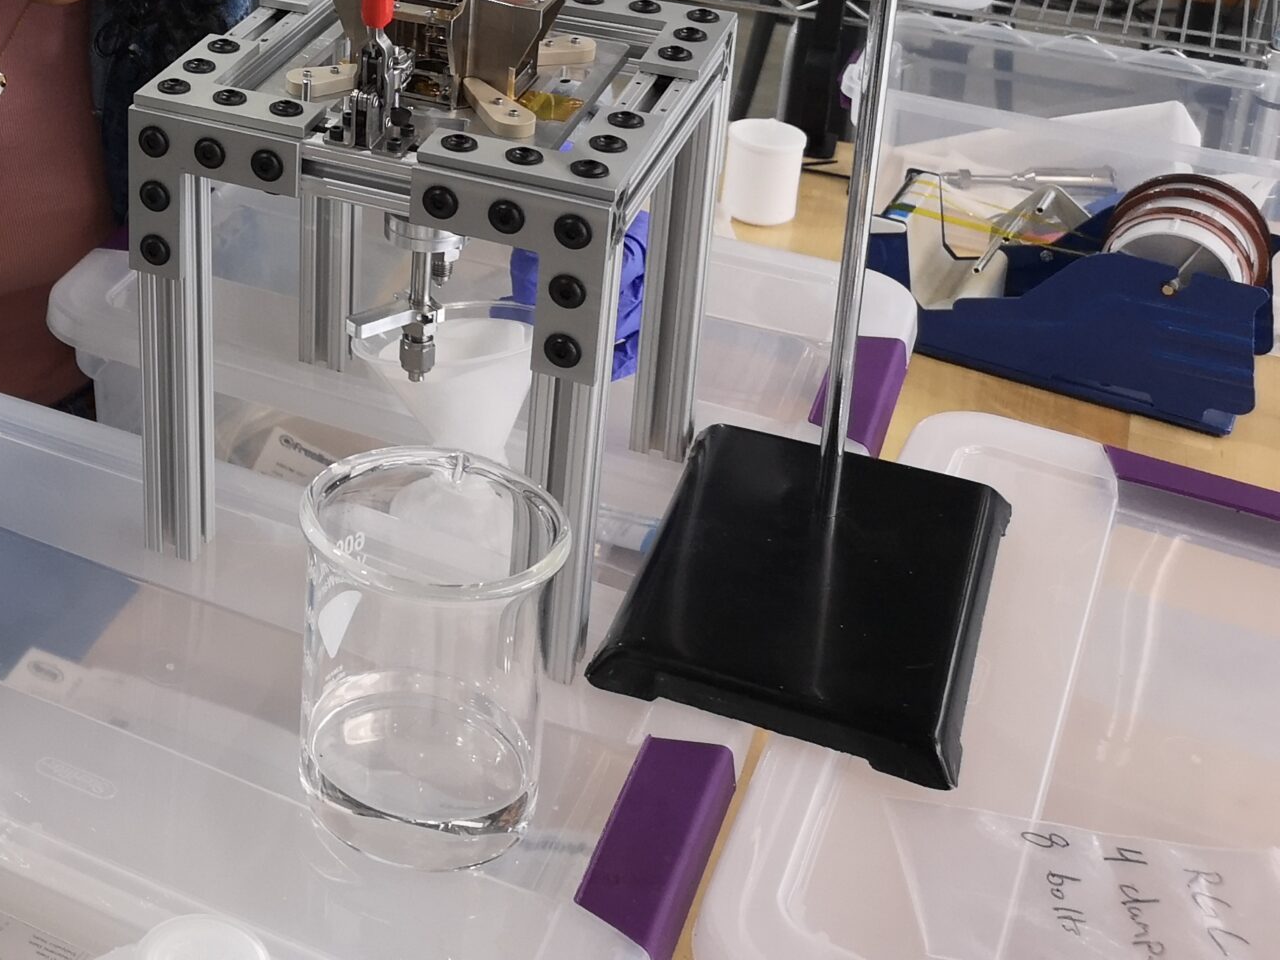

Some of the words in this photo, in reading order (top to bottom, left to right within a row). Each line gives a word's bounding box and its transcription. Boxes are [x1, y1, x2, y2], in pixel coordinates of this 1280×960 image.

[1021, 831, 1070, 848] 8
[1046, 870, 1087, 936] bolts
[1103, 847, 1148, 865] 4
